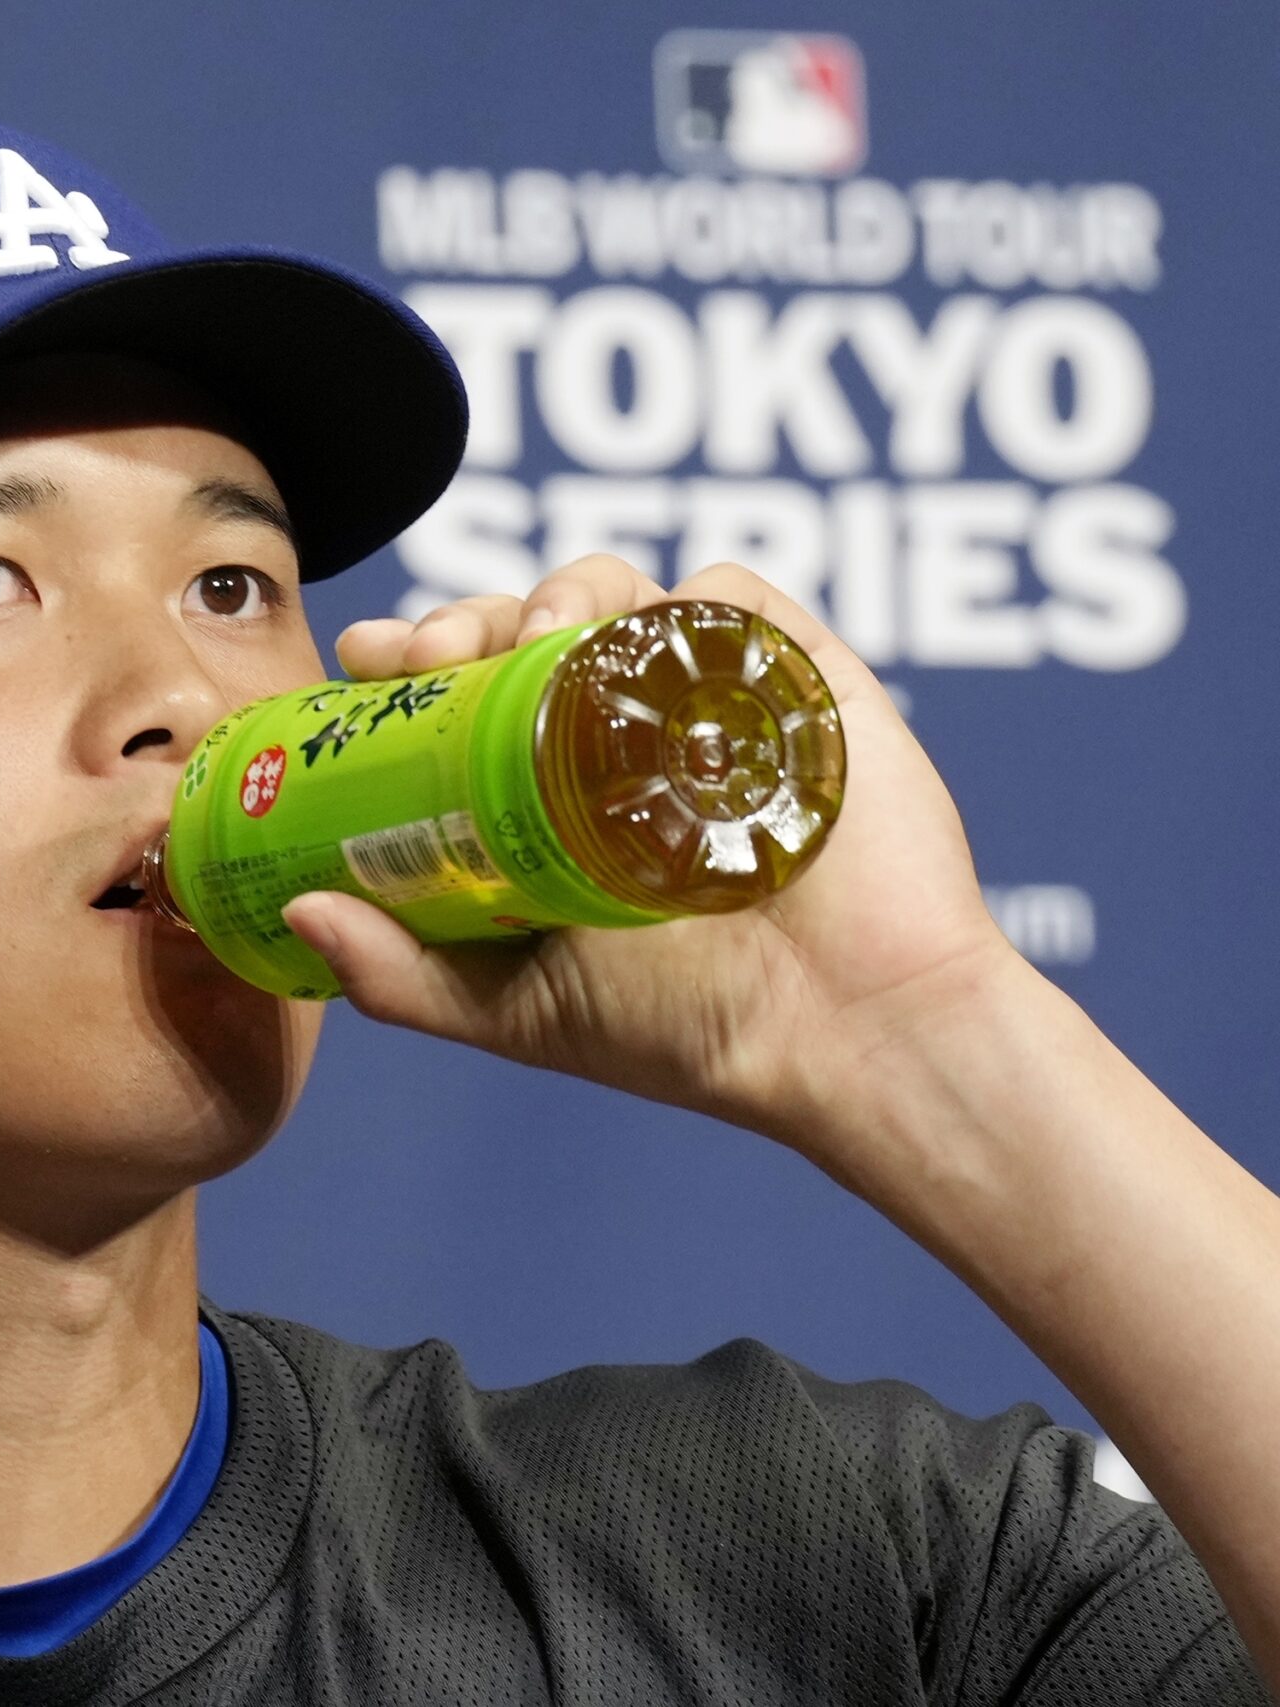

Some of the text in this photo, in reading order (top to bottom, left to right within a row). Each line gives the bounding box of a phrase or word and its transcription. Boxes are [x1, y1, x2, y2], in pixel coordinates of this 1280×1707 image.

[377, 166, 1164, 291] MLB WORLD TOUR
[398, 284, 1153, 483] TOKYO
